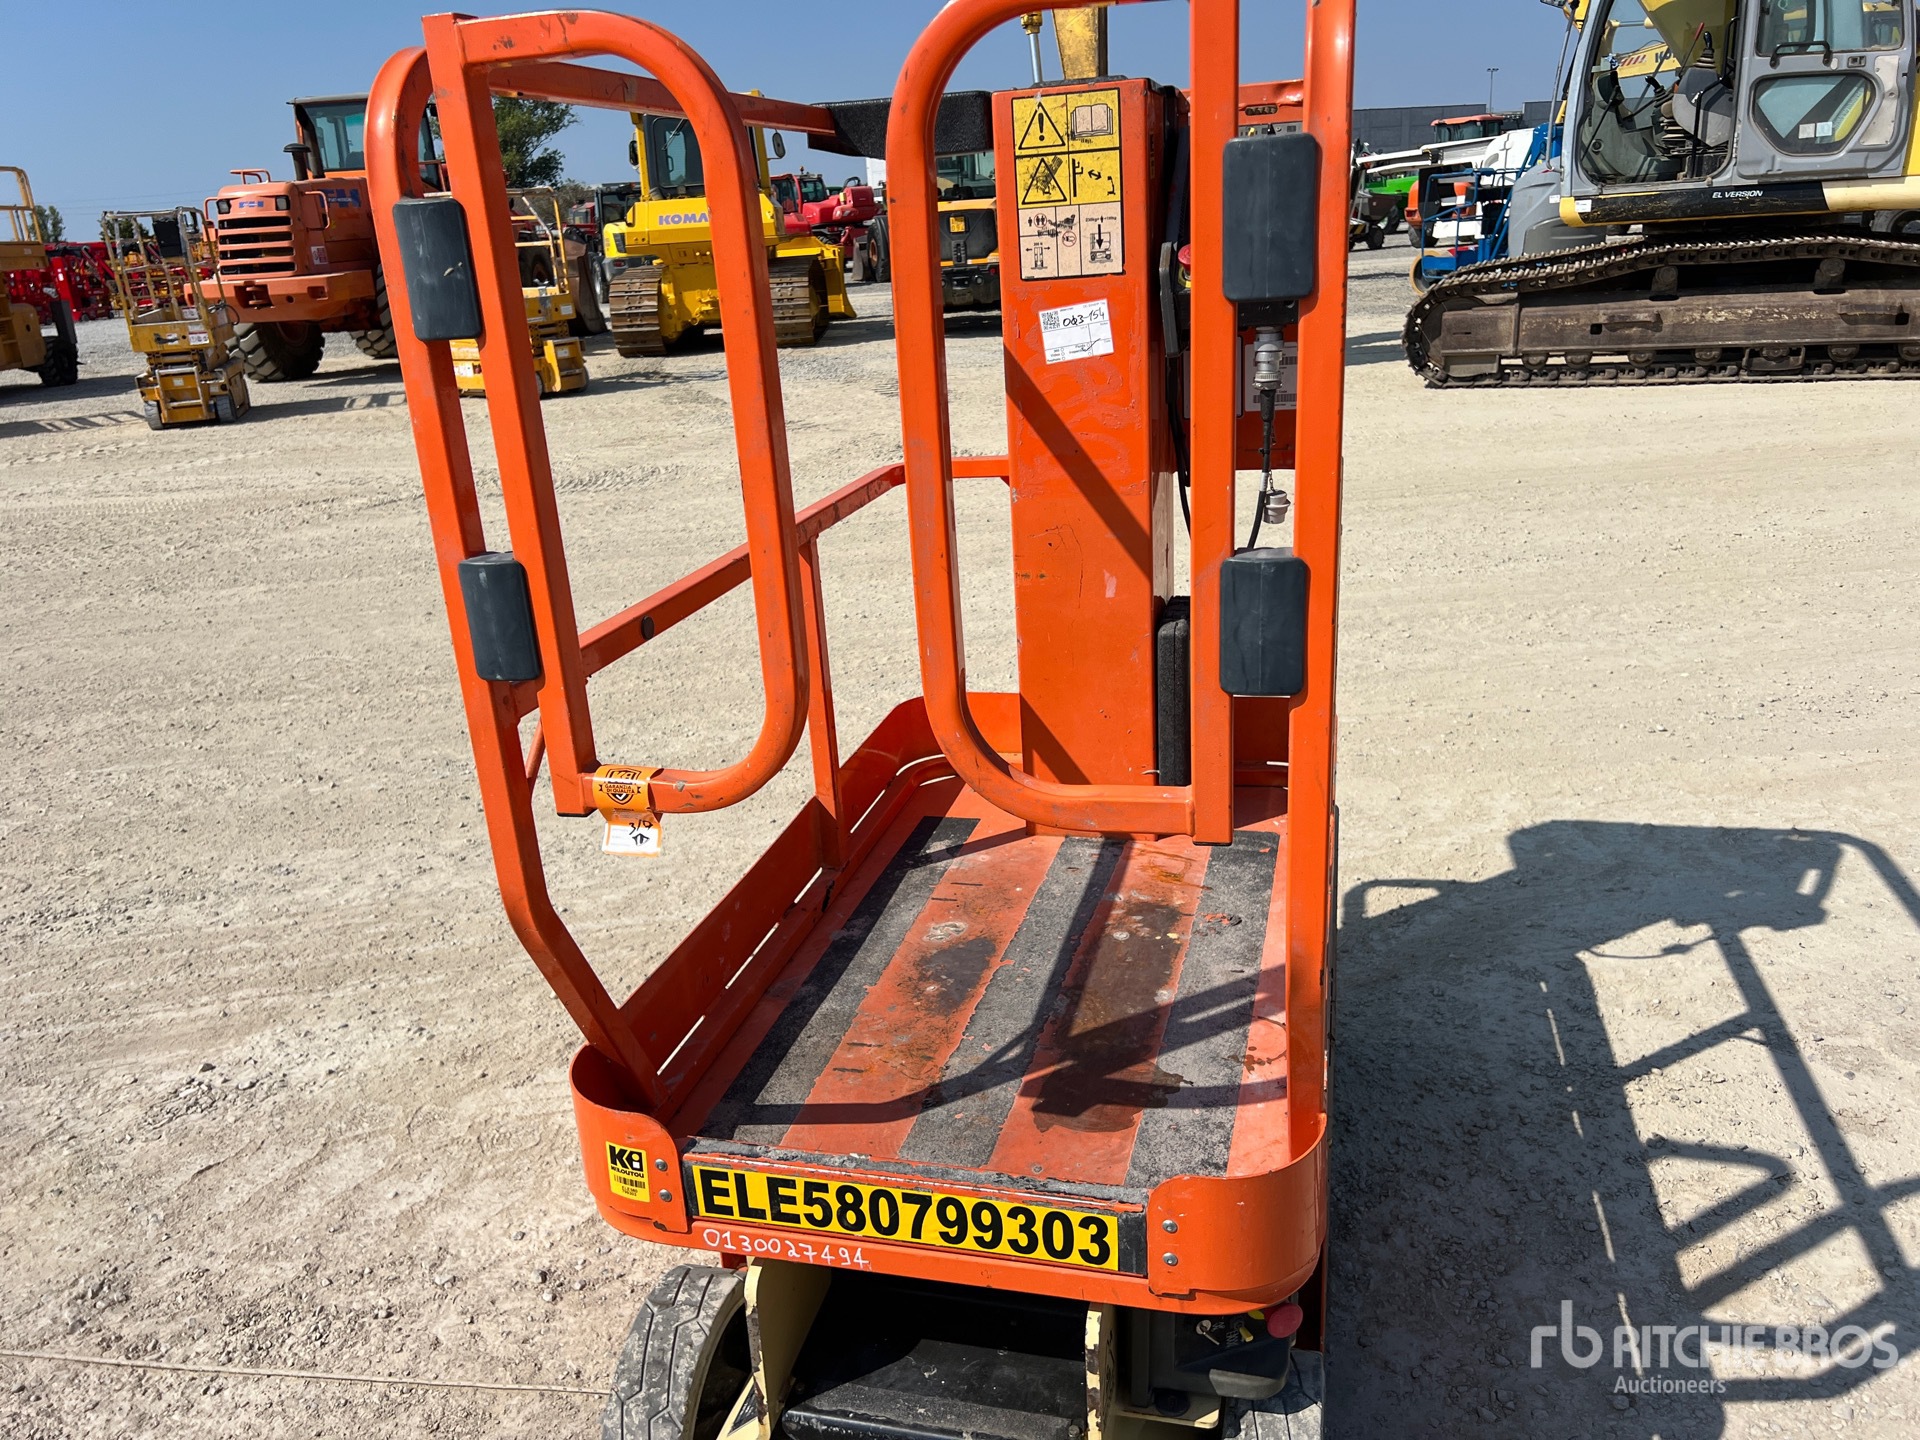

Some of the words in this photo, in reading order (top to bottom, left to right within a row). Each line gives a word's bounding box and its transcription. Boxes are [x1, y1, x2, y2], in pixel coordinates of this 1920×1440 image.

[1725, 190, 1763, 198] VERSION
[699, 1168, 1111, 1267] ELE580799303
[702, 1228, 870, 1270] 0130027494
